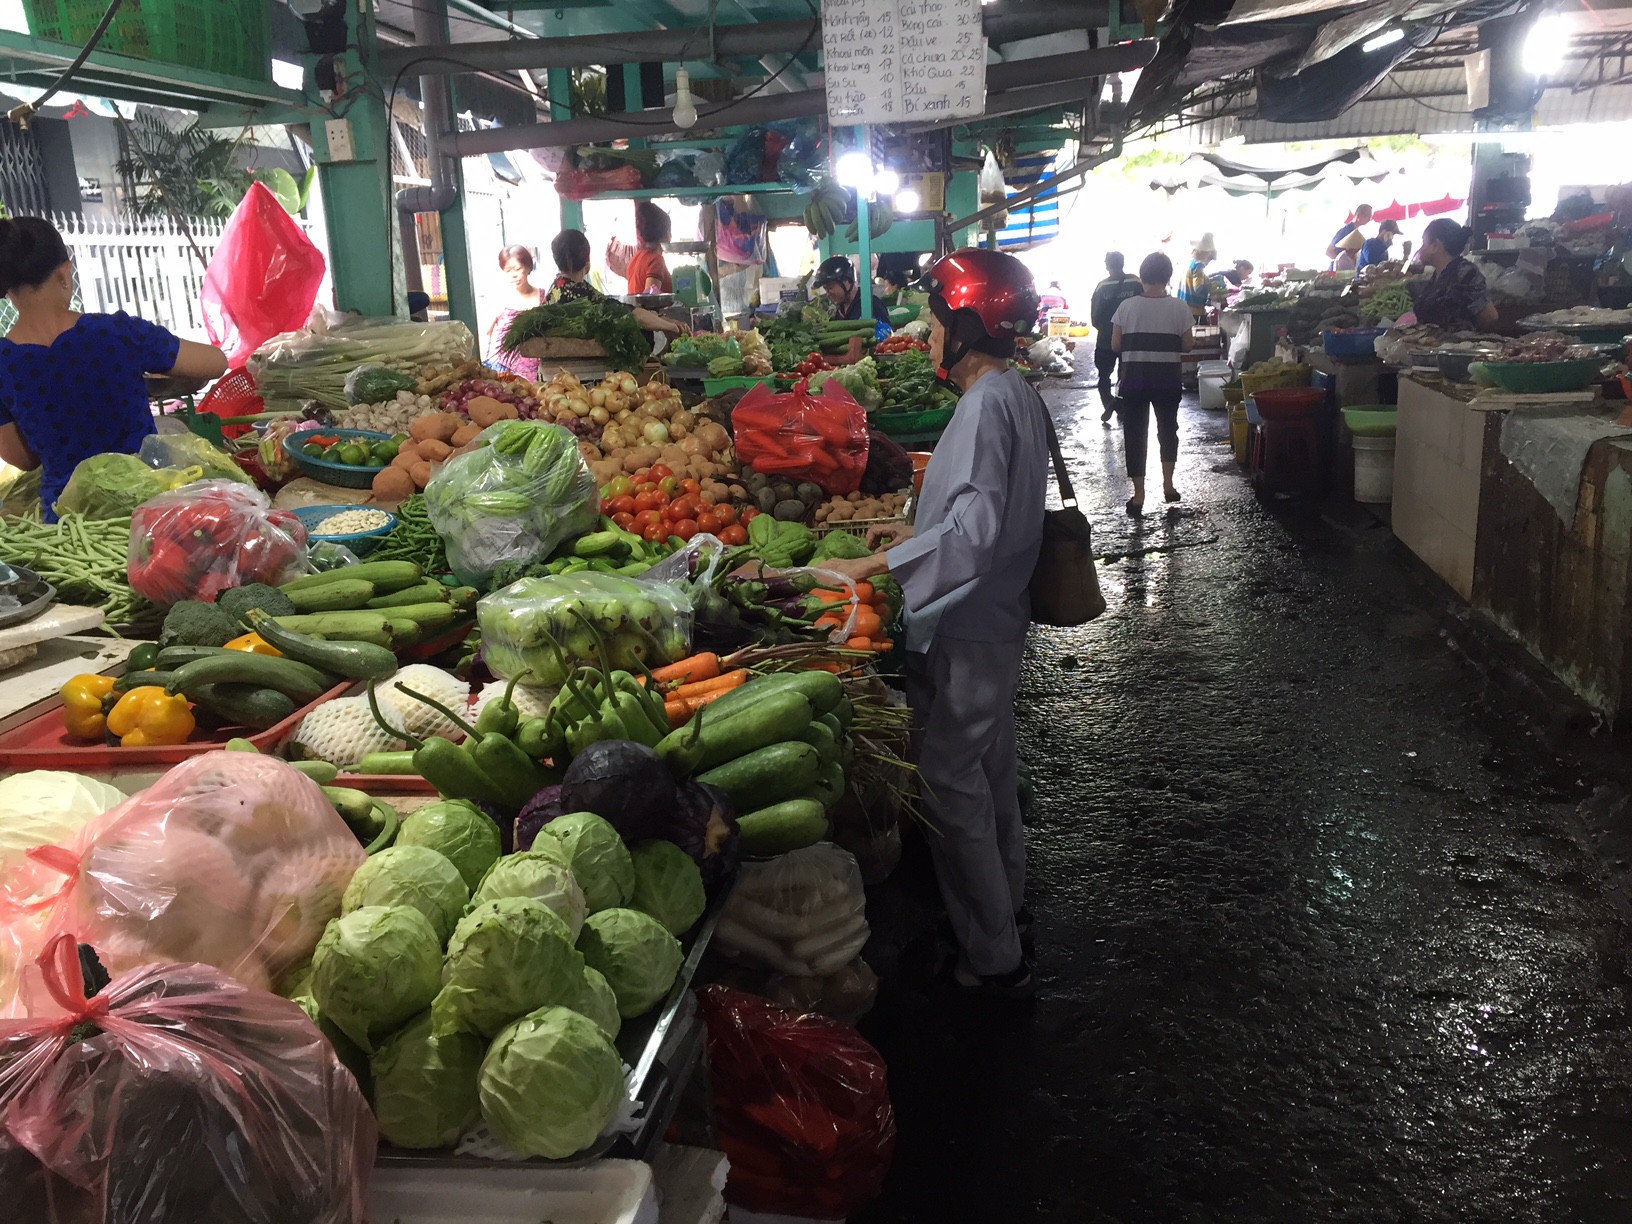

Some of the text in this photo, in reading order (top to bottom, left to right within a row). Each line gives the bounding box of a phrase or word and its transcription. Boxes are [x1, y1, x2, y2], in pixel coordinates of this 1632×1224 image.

[877, 11, 892, 23] 15
[879, 25, 894, 38] 12
[955, 31, 973, 44] 25
[881, 43, 895, 54] 22
[878, 58, 892, 70] 17
[960, 65, 975, 76] 22
[880, 72, 894, 83] 10
[881, 87, 893, 99] 18
